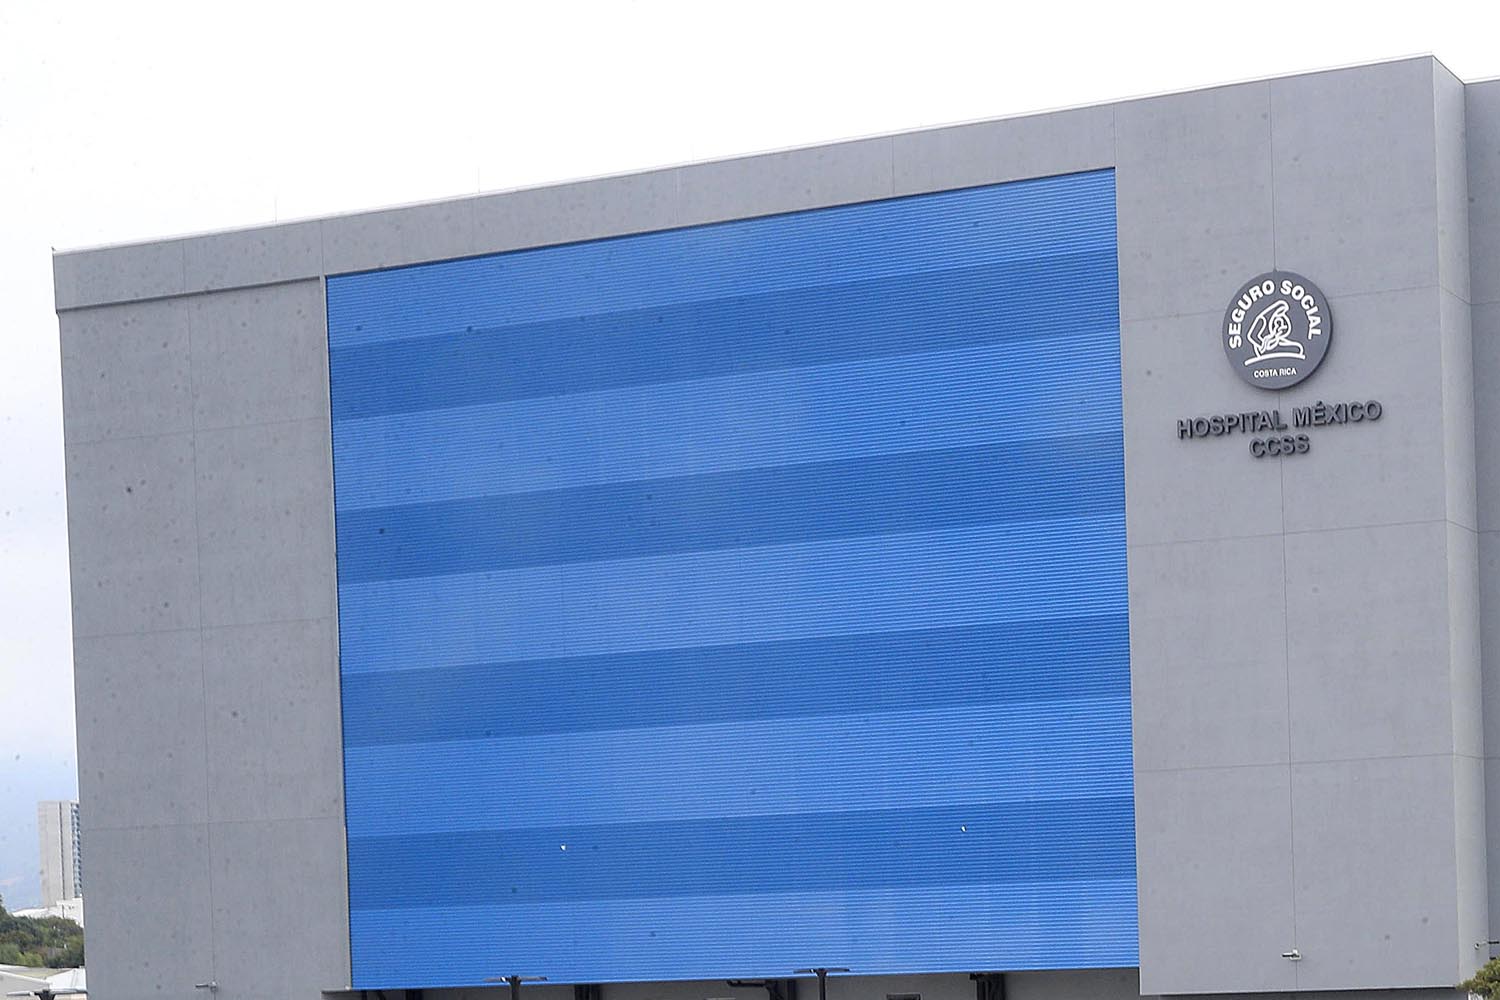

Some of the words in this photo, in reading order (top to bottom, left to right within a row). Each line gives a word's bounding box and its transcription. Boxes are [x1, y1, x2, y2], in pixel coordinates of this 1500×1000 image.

[1228, 279, 1275, 349] SEGURO
[1280, 279, 1322, 340] SOCIAL
[1253, 368, 1278, 378] COSTA
[1279, 367, 1297, 376] RICA
[1177, 410, 1288, 439] HOSPITAL
[1292, 400, 1382, 428] MÉXICO
[1249, 434, 1311, 458] CCSS
